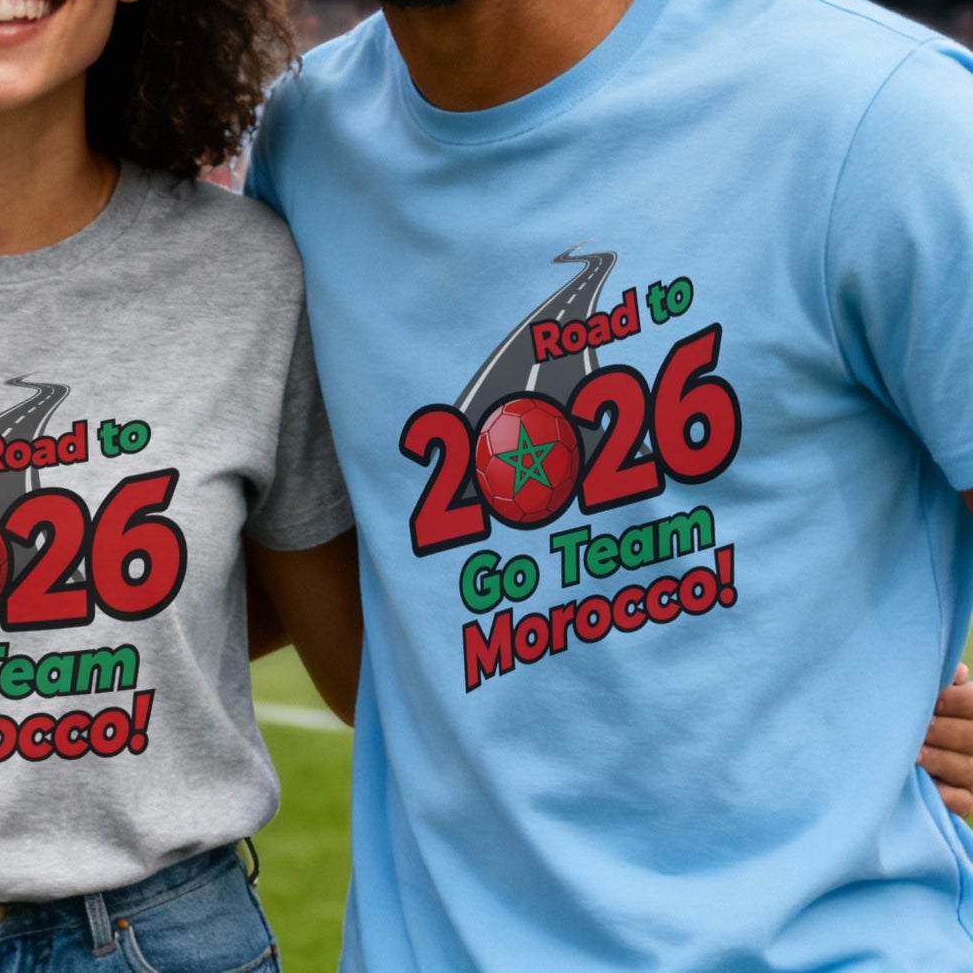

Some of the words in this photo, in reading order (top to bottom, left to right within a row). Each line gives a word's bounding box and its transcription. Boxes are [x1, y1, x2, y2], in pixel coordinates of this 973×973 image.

[530, 286, 641, 364] Road
[646, 276, 694, 325] to
[98, 419, 151, 458] to
[399, 323, 741, 557] 2026
[460, 549, 540, 614] Go
[550, 506, 716, 588] Team
[462, 543, 738, 693] Morocco!
